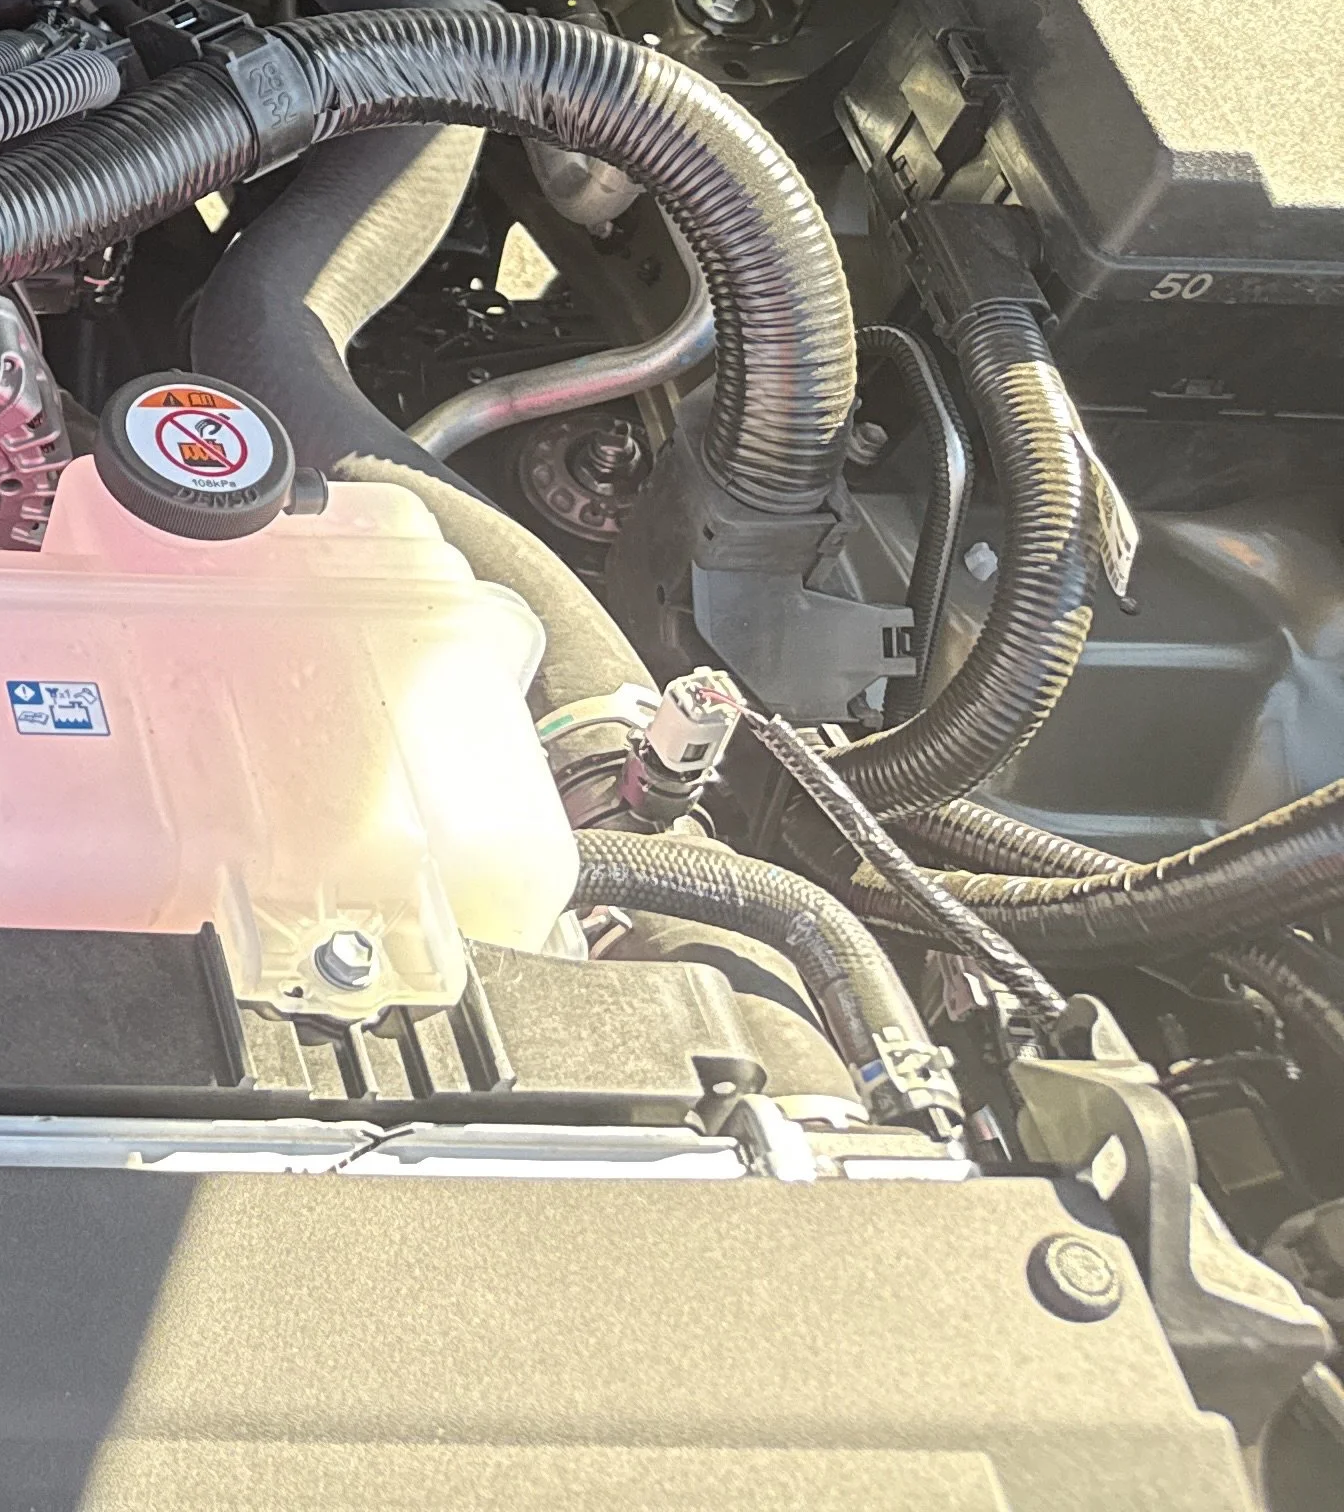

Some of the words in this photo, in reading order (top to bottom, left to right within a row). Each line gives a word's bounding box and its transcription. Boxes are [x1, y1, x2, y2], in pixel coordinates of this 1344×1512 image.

[249, 61, 285, 100] 28
[262, 90, 298, 128] 32
[1149, 272, 1213, 300] 50
[192, 478, 237, 489] 108kPa
[173, 487, 261, 509] DENSO
